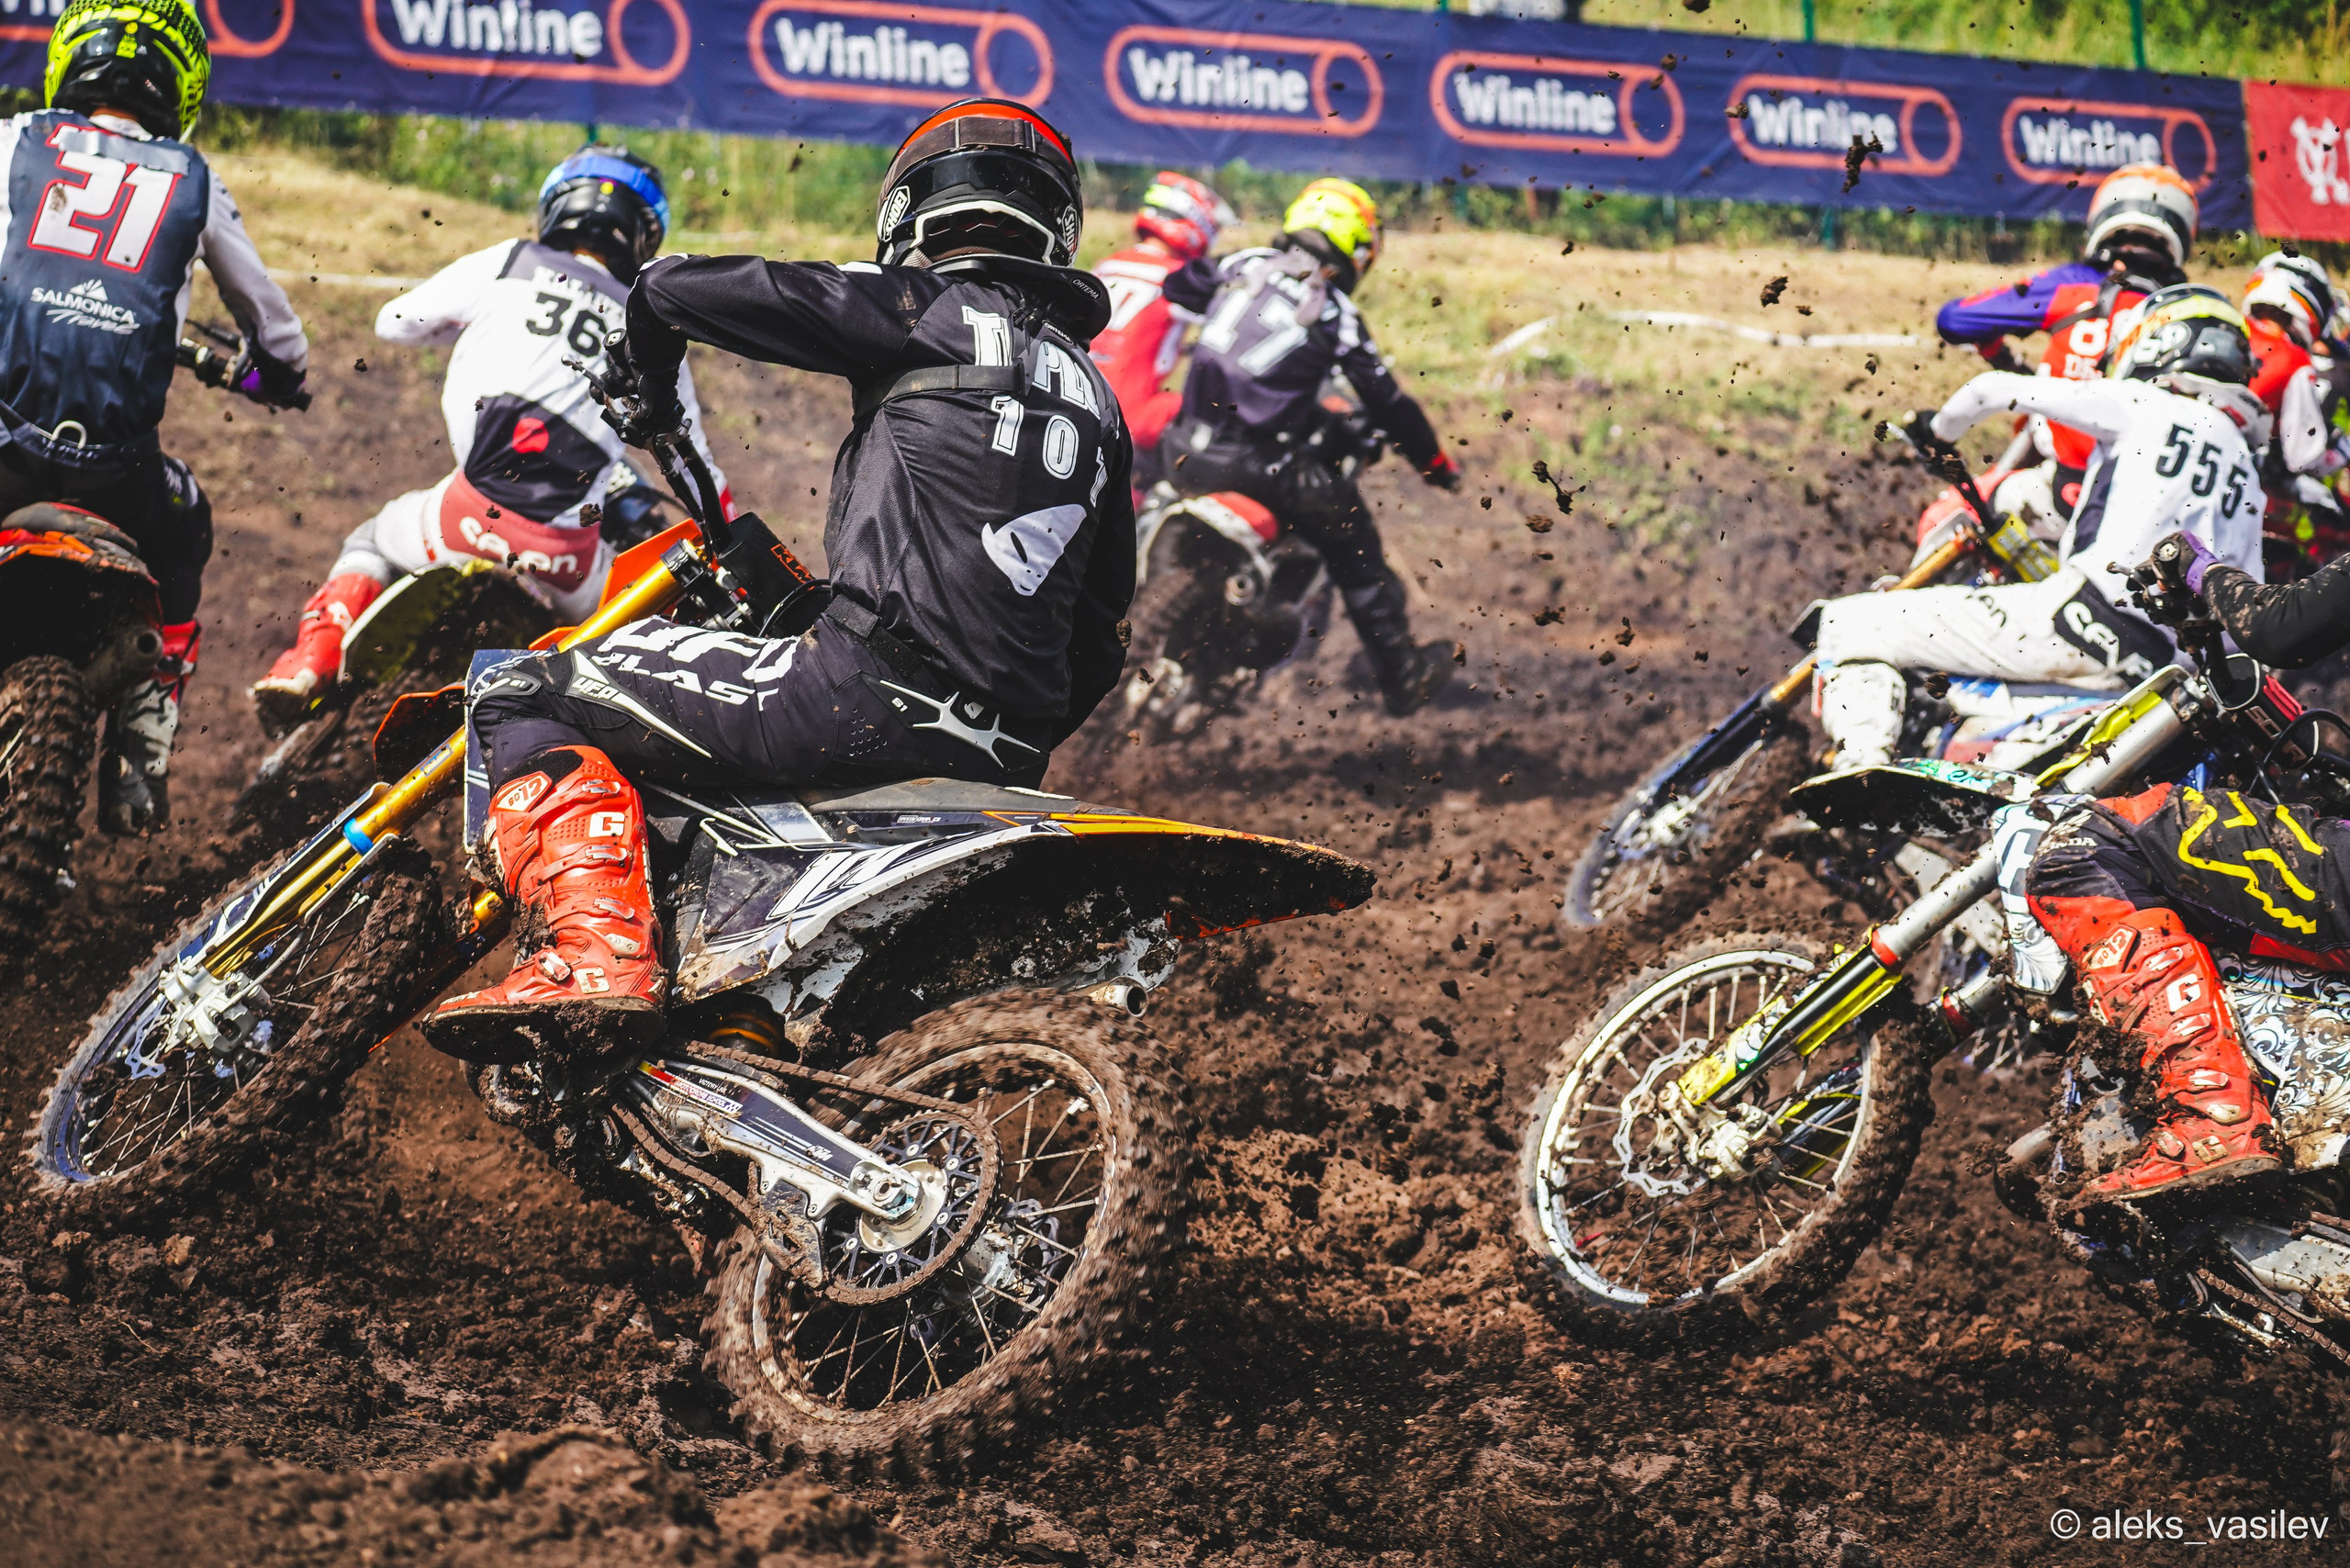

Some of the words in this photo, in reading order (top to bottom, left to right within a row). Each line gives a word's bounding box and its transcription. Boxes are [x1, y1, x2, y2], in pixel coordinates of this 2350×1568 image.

[392, 0, 603, 58] Winline
[774, 17, 970, 88] Winline
[1127, 47, 1309, 113] Winline
[1453, 72, 1617, 134] Winline
[1747, 94, 1897, 154] Winline
[2019, 115, 2162, 167] Winline
[28, 147, 181, 273] 21
[30, 286, 136, 323] SALMONICA
[1072, 278, 1100, 299] ORTEMA
[526, 291, 608, 358] 36
[1199, 286, 1308, 377] 17
[2155, 423, 2248, 520] 555
[571, 677, 619, 700] UFO
[589, 812, 625, 837] G
[575, 967, 610, 994] G
[2166, 973, 2201, 1012] G
[2192, 1135, 2228, 1163] G
